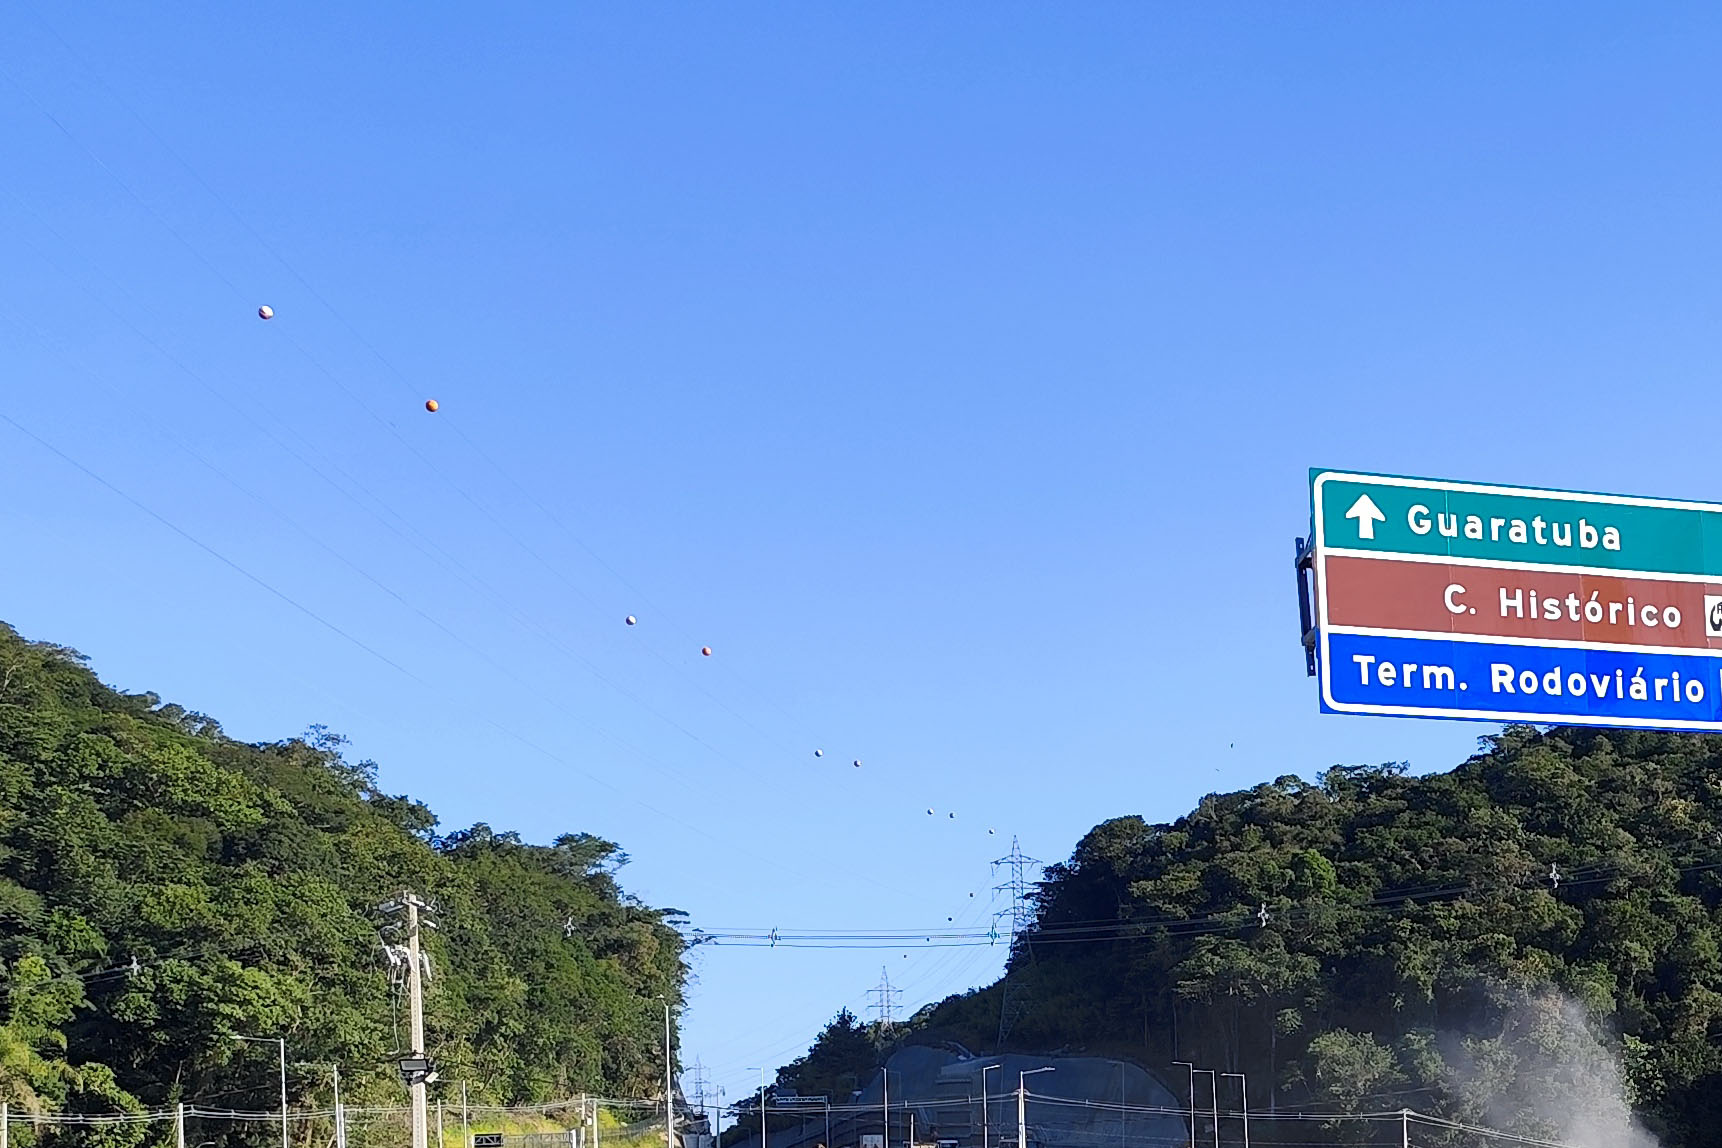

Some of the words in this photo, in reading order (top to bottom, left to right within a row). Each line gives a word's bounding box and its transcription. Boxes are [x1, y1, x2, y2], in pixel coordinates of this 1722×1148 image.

[1407, 504, 1622, 551] Guaratuba
[1443, 583, 1477, 615] C.
[1499, 587, 1681, 628] Histórico
[1352, 654, 1468, 691] Term.
[1490, 663, 1705, 703] Rodoviário
